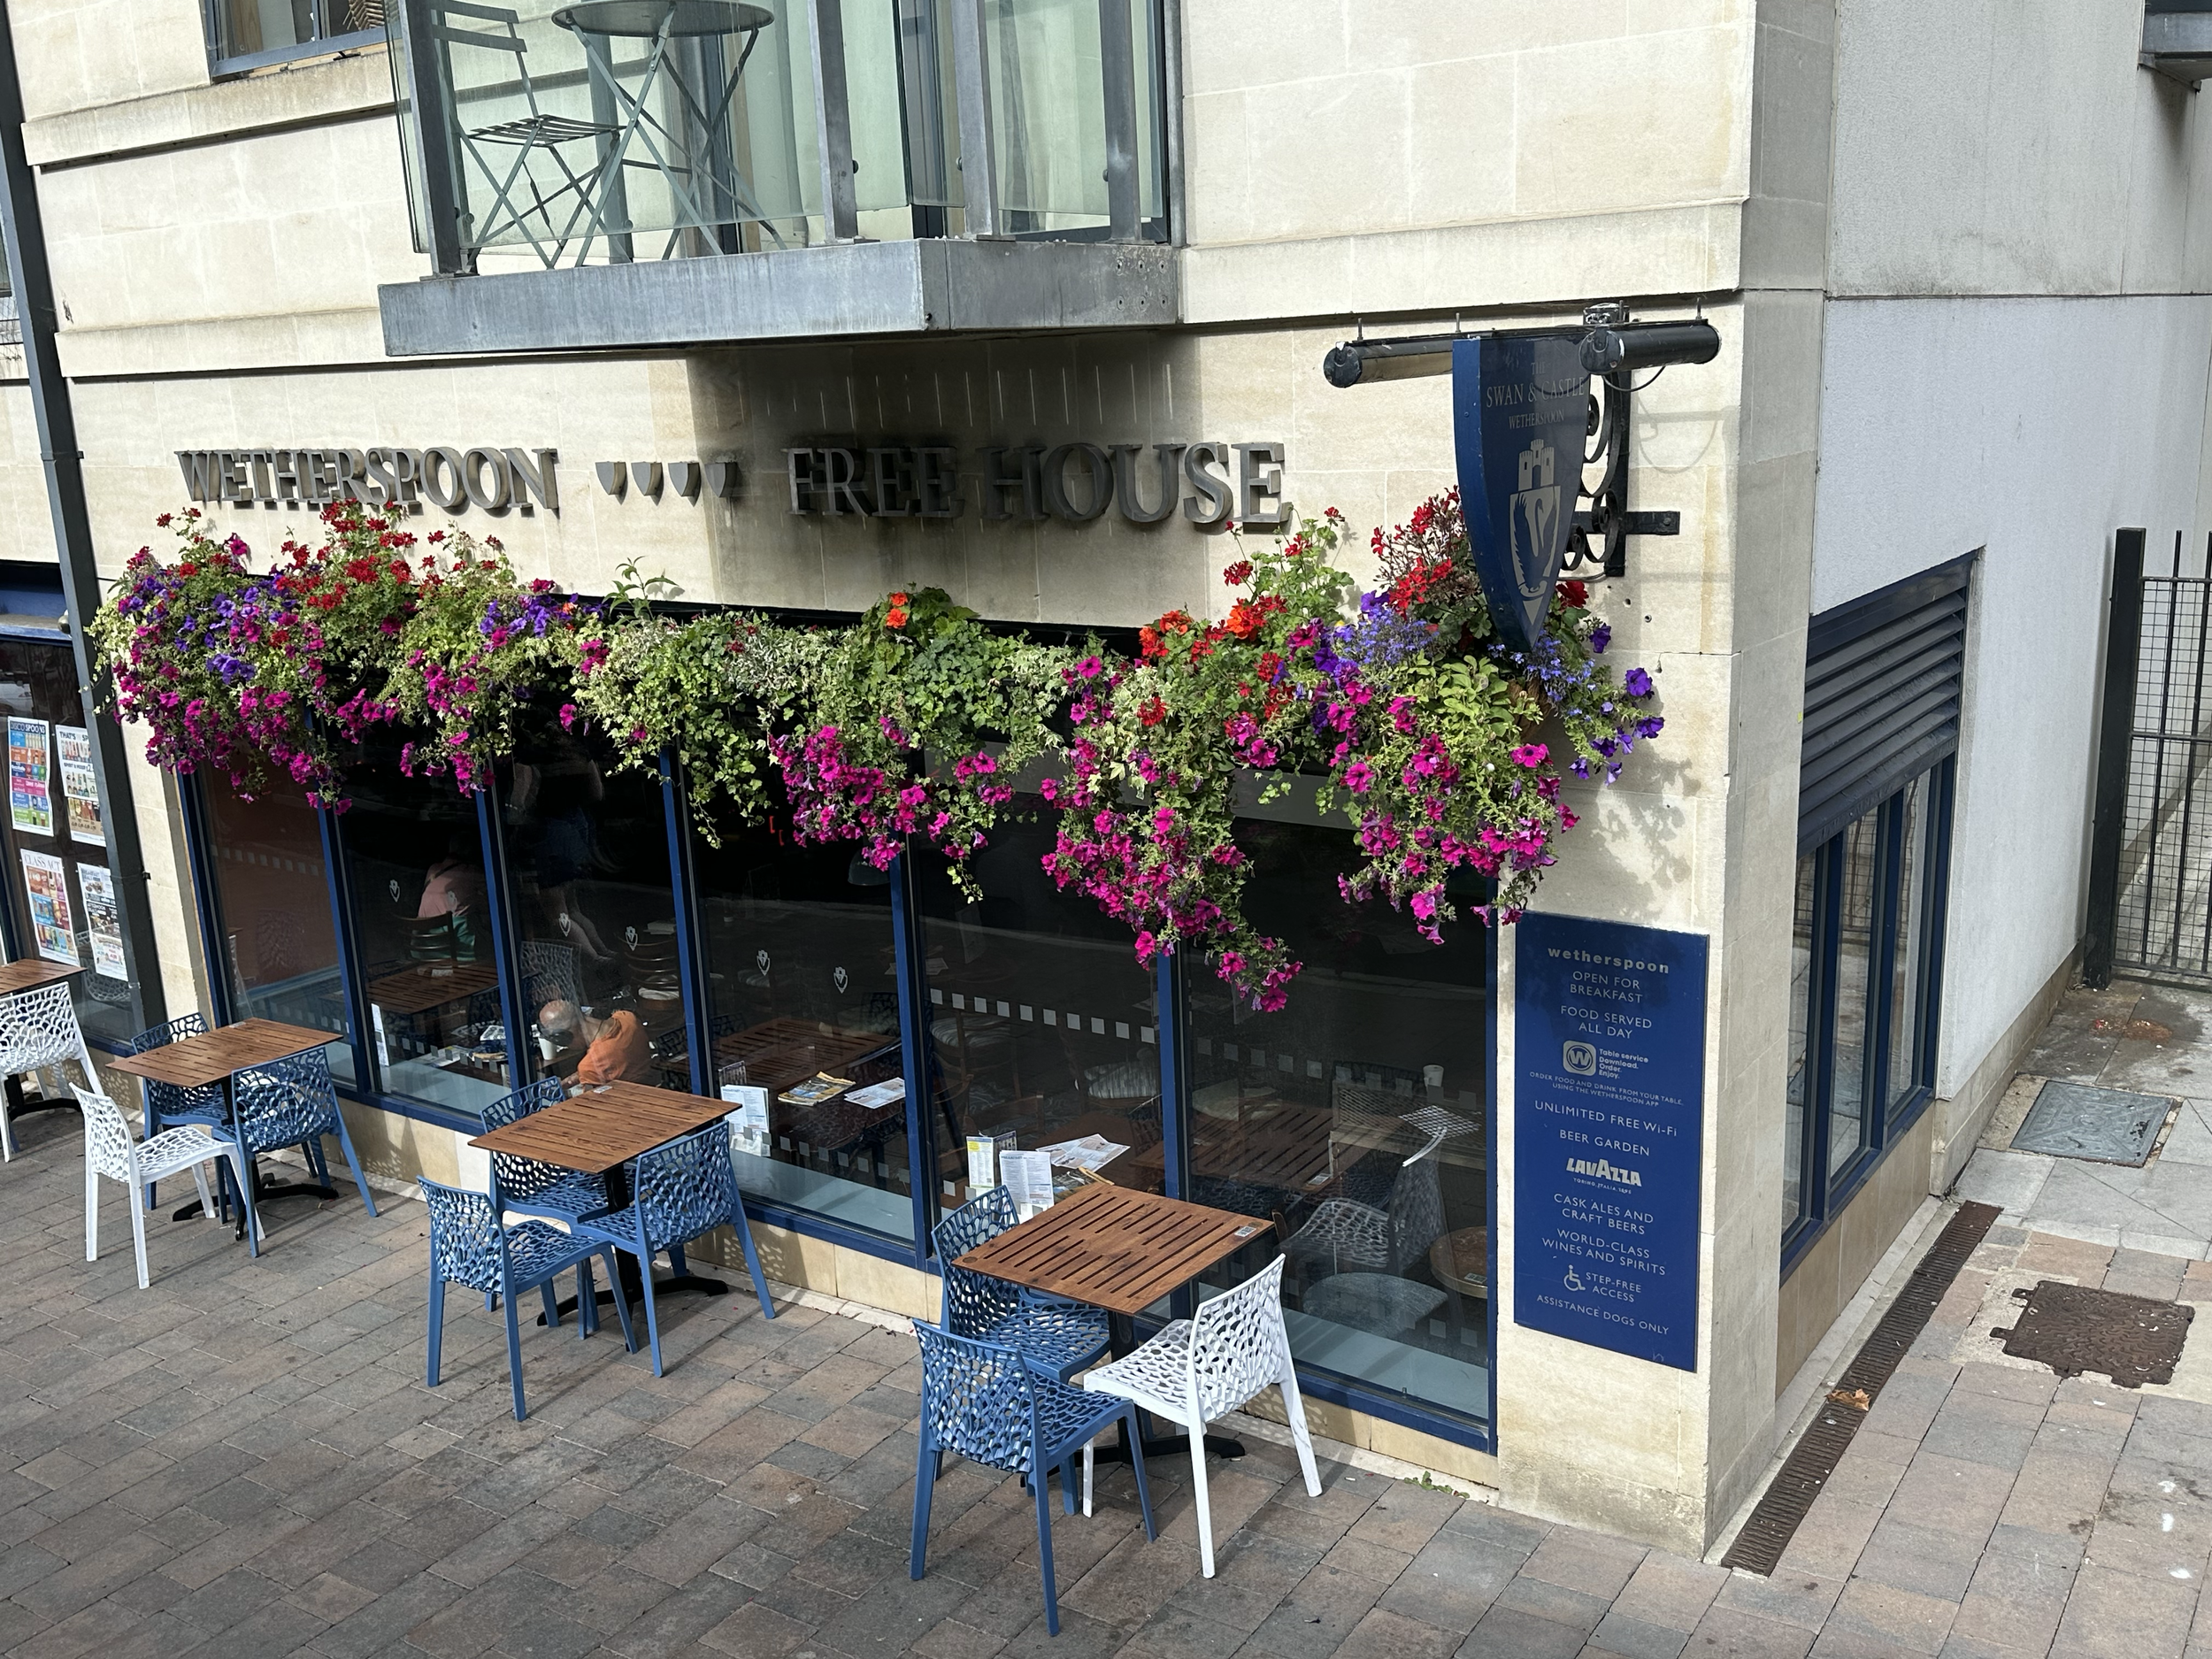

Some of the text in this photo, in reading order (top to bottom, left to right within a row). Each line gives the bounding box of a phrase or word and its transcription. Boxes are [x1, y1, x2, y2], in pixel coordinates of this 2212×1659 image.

[1531, 362, 1546, 375] THE
[1486, 376, 1585, 408] SWAN & CASTLE
[1509, 409, 1564, 430] WETHERSPOON
[173, 442, 1291, 524] WETHERSPOON FREE HOUSE
[1548, 948, 1669, 973] wetherspoon
[1572, 971, 1640, 989] OPEN FOR
[1570, 983, 1643, 1003] BREAKFAST
[1561, 1005, 1652, 1028] FOOD SERVED
[1578, 1022, 1632, 1039] ALL DAY
[1599, 1048, 1648, 1064] Table service
[1529, 1071, 1553, 1080] ORDER
[1555, 1076, 1575, 1085] FOOD
[1594, 1083, 1617, 1092] DRINK
[1619, 1087, 1639, 1096] FROM
[1640, 1092, 1659, 1101] YOUR
[1552, 1083, 1574, 1092] USING
[1590, 1089, 1644, 1104] WETHERSPOON
[1535, 1101, 1677, 1137] UNLIMITED FREE Wi-Fi
[1560, 1130, 1649, 1156] BEER GARDEN
[1566, 1157, 1642, 1187] LAVAZZA
[1554, 1194, 1654, 1223] CASK ALES AND
[1562, 1209, 1645, 1234] CRAFT BEERS
[1557, 1228, 1649, 1258] WORLD-CLASS
[1541, 1238, 1665, 1275] WINES AND SPIRITS
[1586, 1272, 1641, 1293] STEP-FREE
[1593, 1286, 1634, 1302] ACCESS
[1537, 1294, 1669, 1335] ASSISTANCE DOGS ONLY
